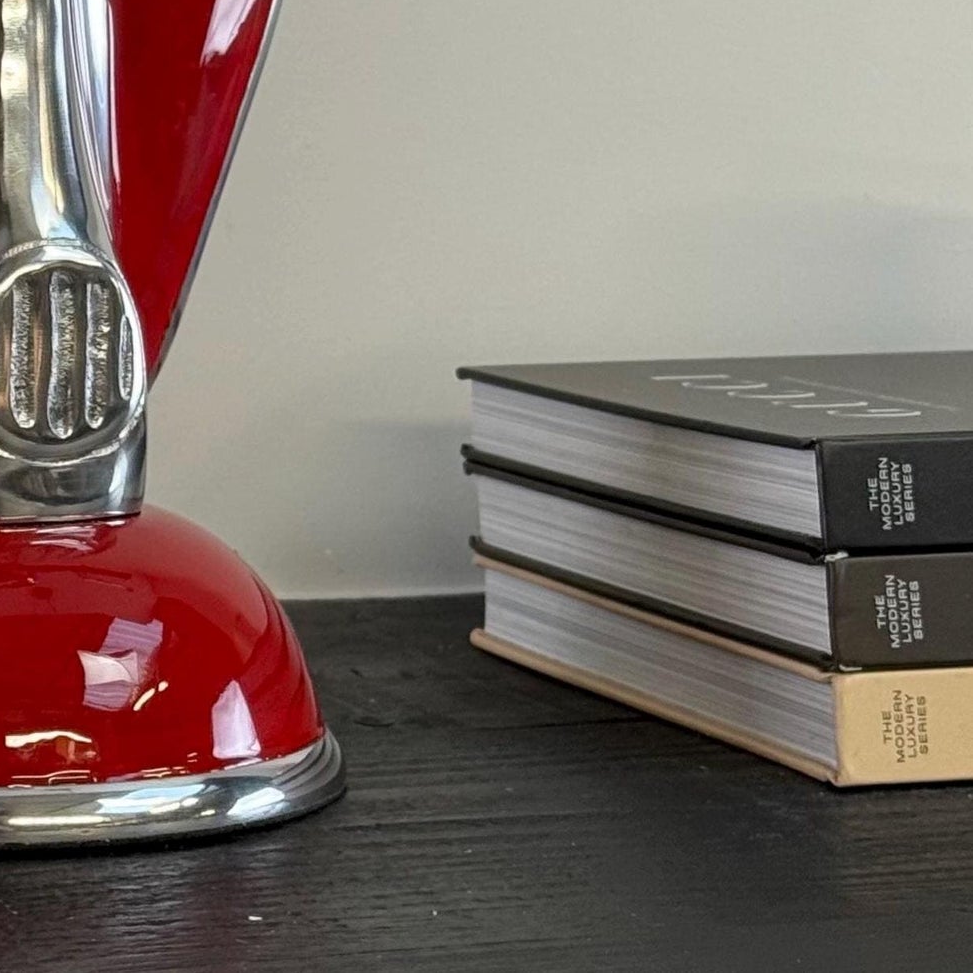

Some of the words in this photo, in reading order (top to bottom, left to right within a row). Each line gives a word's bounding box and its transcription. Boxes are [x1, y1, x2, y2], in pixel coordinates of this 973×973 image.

[867, 477, 879, 511] THE
[878, 457, 892, 530] MODERN
[890, 461, 904, 525] LUXURY
[902, 463, 915, 522] SERIES
[874, 595, 886, 629] THE
[885, 574, 900, 648] MODERN
[897, 579, 912, 643] LUXURY
[909, 580, 924, 640] SERIES
[881, 711, 892, 744] THE
[892, 689, 905, 763] MODERN
[905, 694, 917, 758] LUXURY
[917, 696, 929, 755] SERIES
